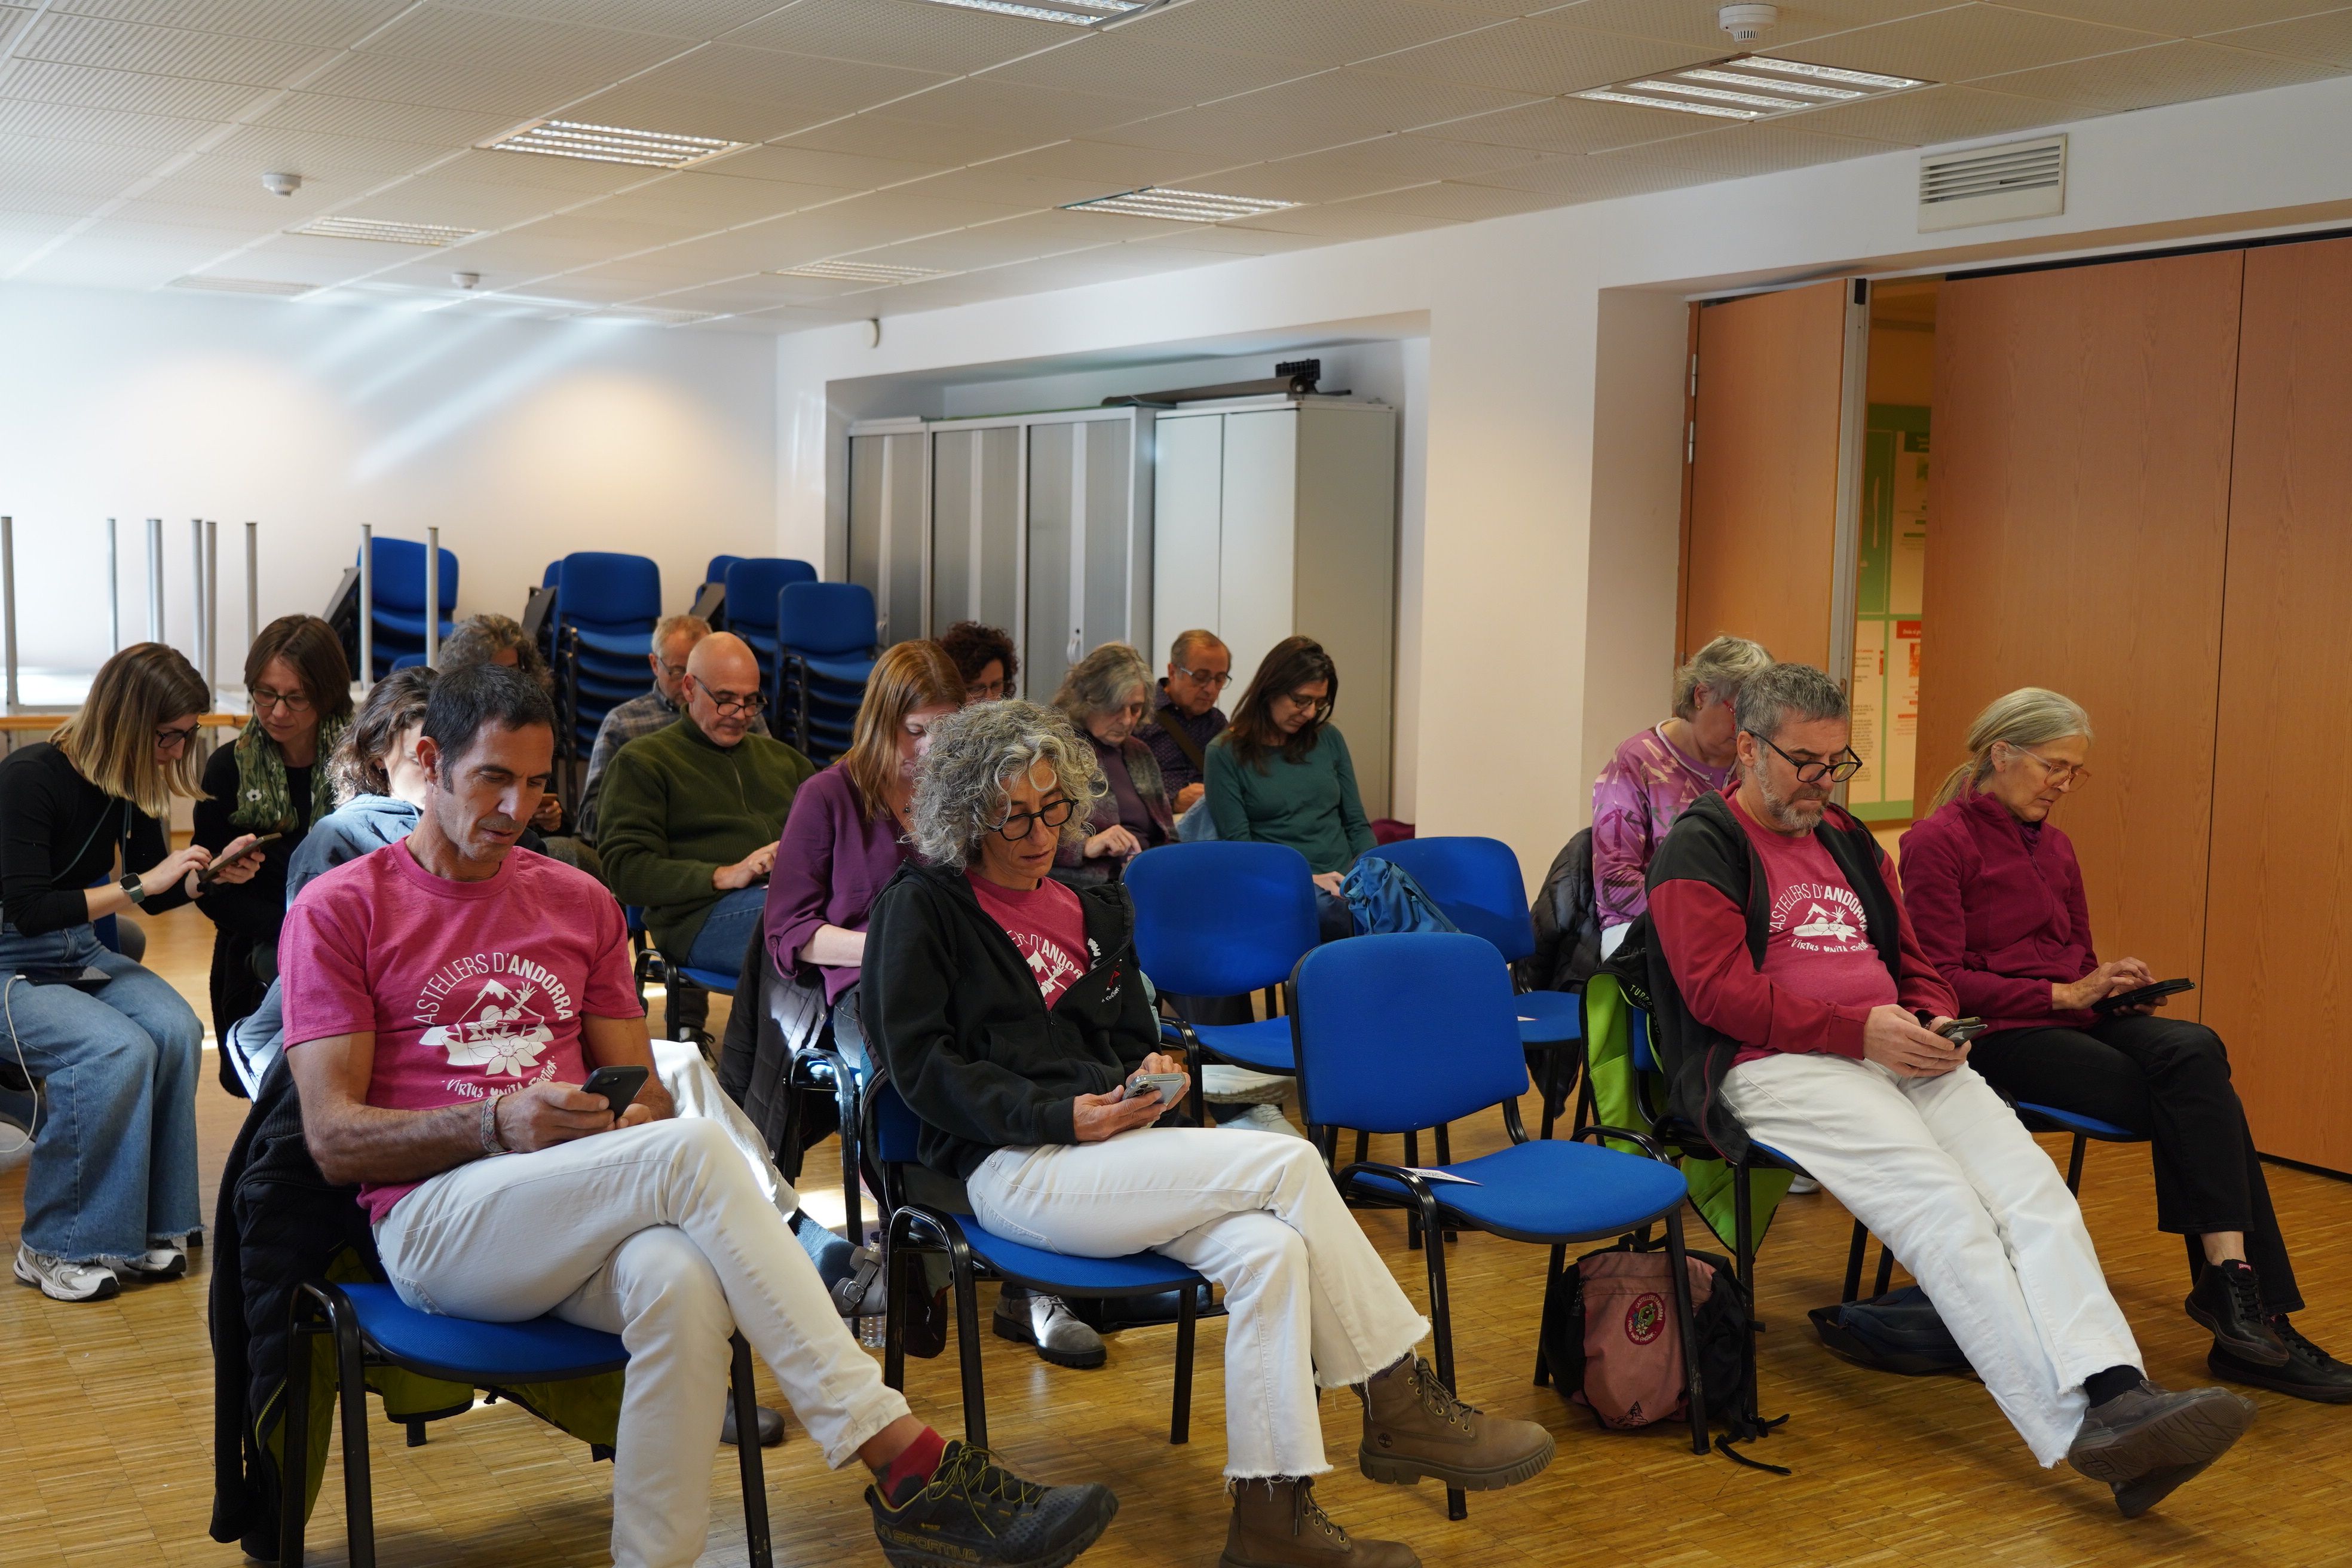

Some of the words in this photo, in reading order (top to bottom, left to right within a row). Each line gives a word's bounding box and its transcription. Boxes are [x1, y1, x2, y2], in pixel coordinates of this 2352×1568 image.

[1769, 883, 1811, 932] ASTELLERS
[413, 953, 489, 1027] ASTELLERS
[493, 951, 574, 1021] D'ANDORRA
